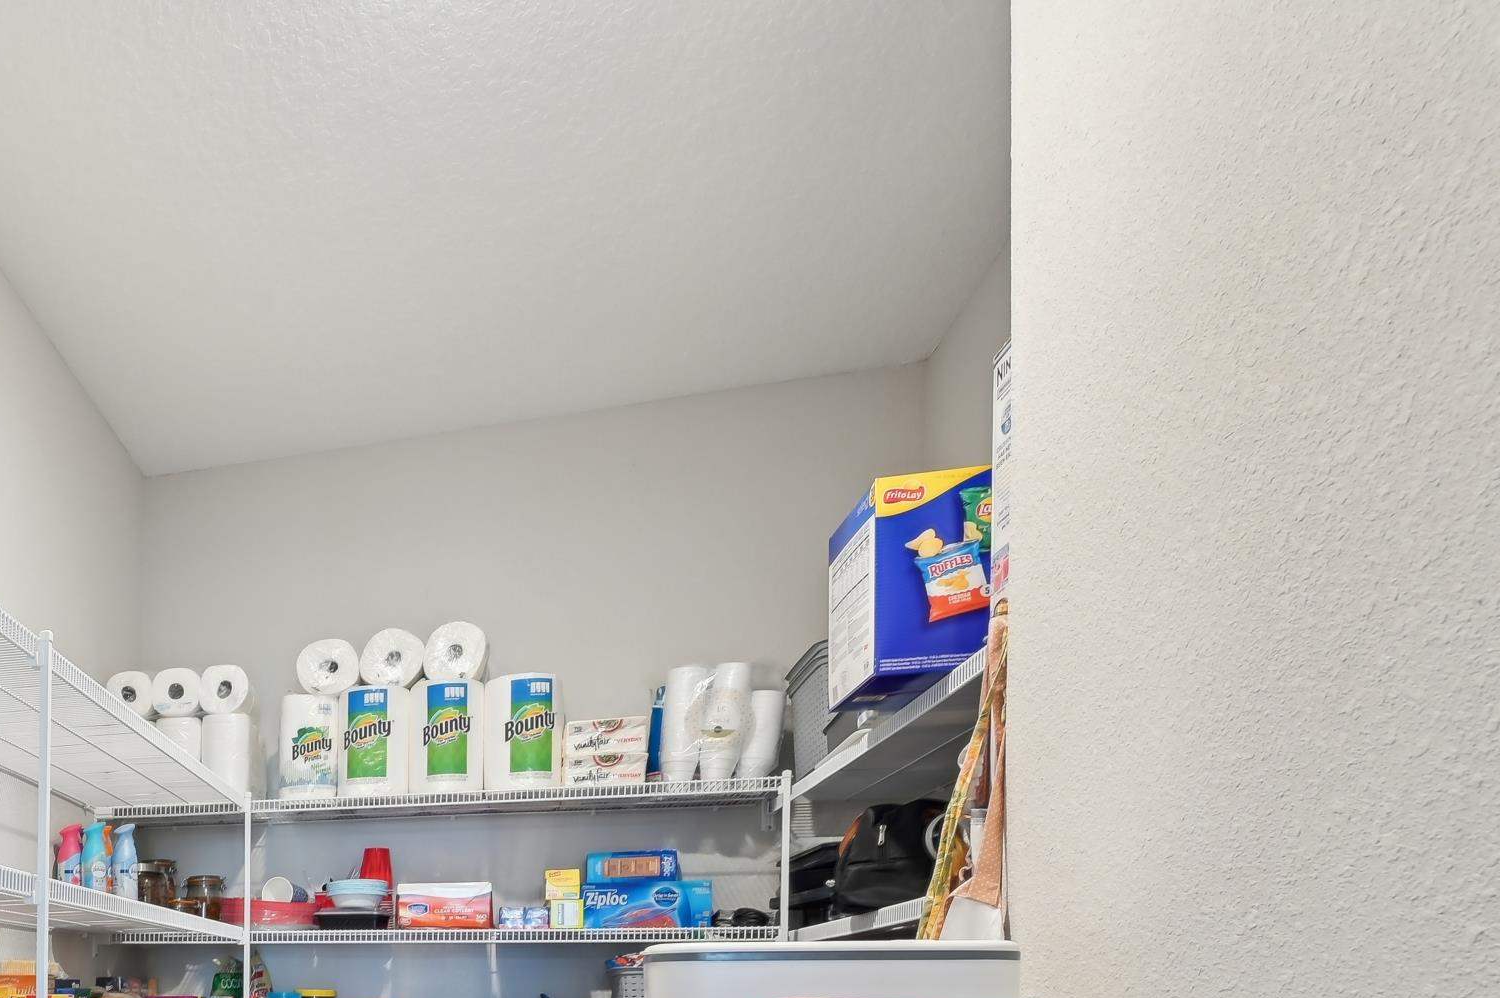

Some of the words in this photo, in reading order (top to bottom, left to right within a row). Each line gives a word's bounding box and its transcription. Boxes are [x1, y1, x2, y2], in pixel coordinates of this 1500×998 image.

[928, 555, 972, 577] RUFFLES
[343, 719, 392, 750] Bounty
[423, 715, 471, 746] Bounty
[504, 710, 556, 742] Bounty
[292, 737, 332, 761] Bounty
[585, 891, 628, 909] Ziploc
